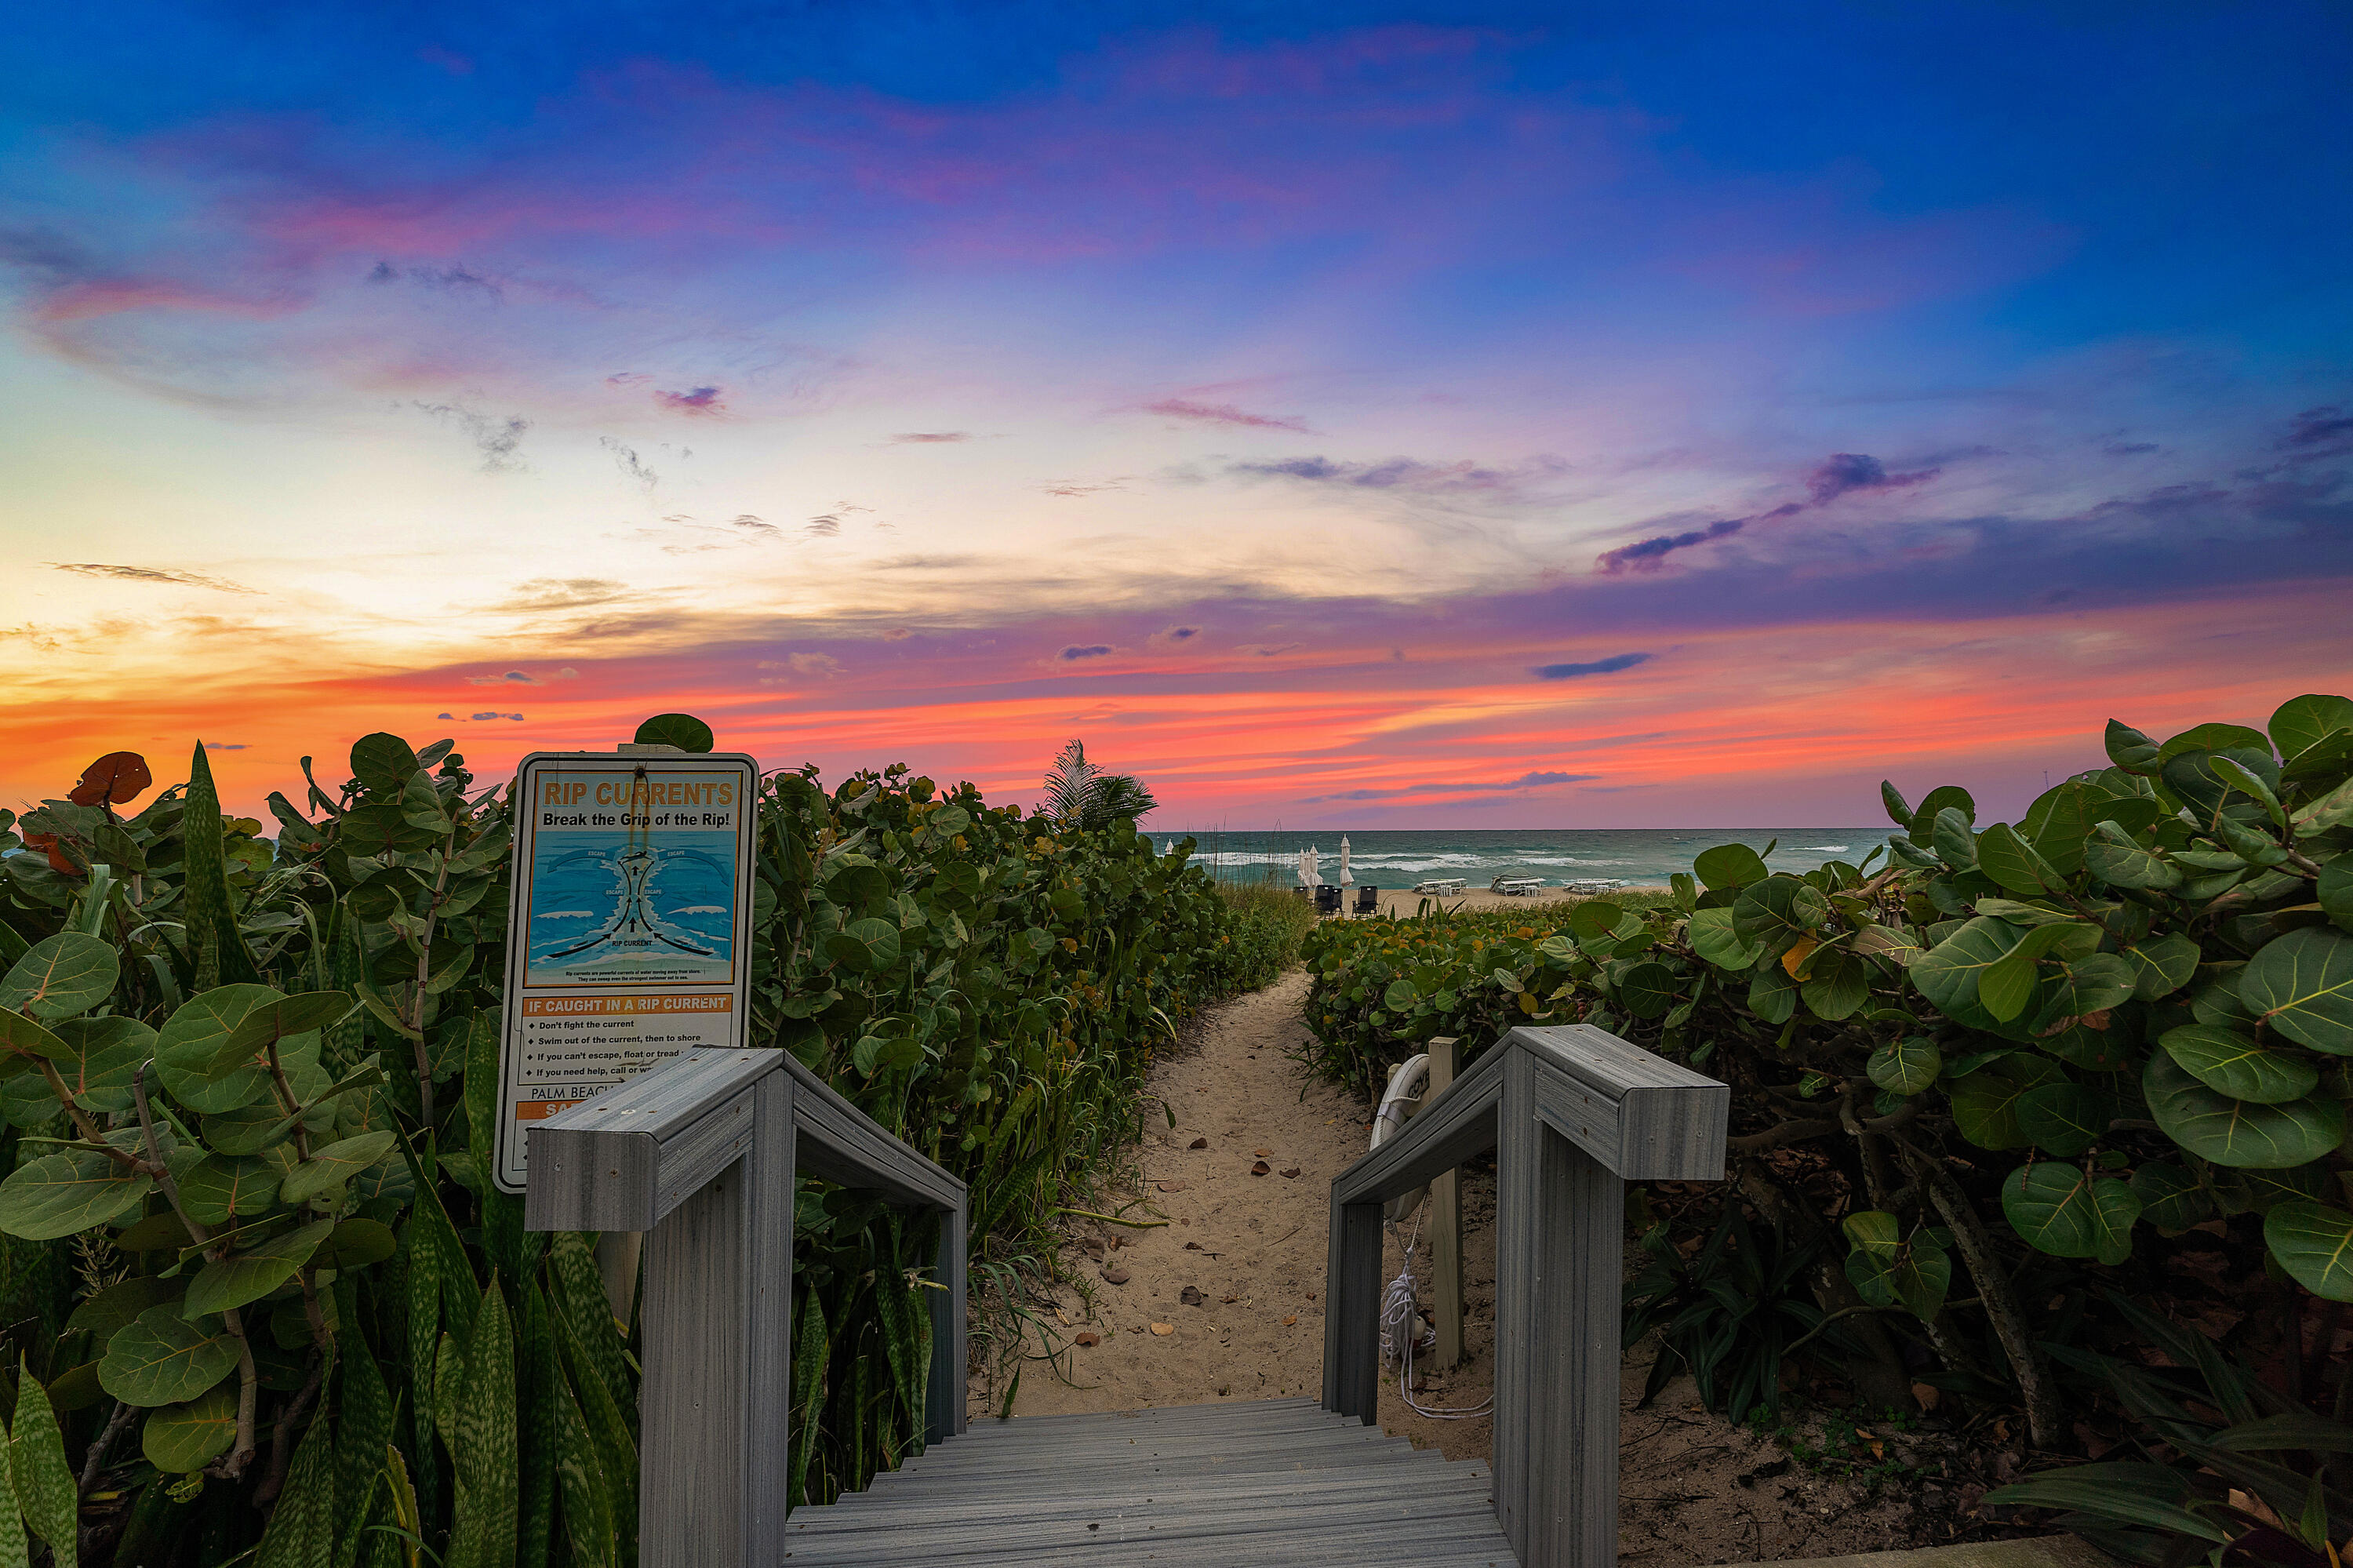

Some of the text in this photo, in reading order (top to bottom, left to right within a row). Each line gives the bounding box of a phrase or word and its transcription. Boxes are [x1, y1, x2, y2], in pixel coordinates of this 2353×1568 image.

[543, 782, 733, 806] RIP CURRENTS
[543, 813, 730, 828] Break the Grip of the Rip!
[529, 997, 726, 1013] IF CAUGHT IN A RIP CURRENT
[563, 1020, 584, 1031] fight
[538, 1037, 562, 1046] Swim
[609, 1036, 642, 1045] current,
[677, 1034, 701, 1042] shore
[547, 1053, 562, 1063] you
[564, 1052, 587, 1060] can't
[587, 1067, 608, 1076] help,
[532, 1086, 613, 1099] PALM BEAC
